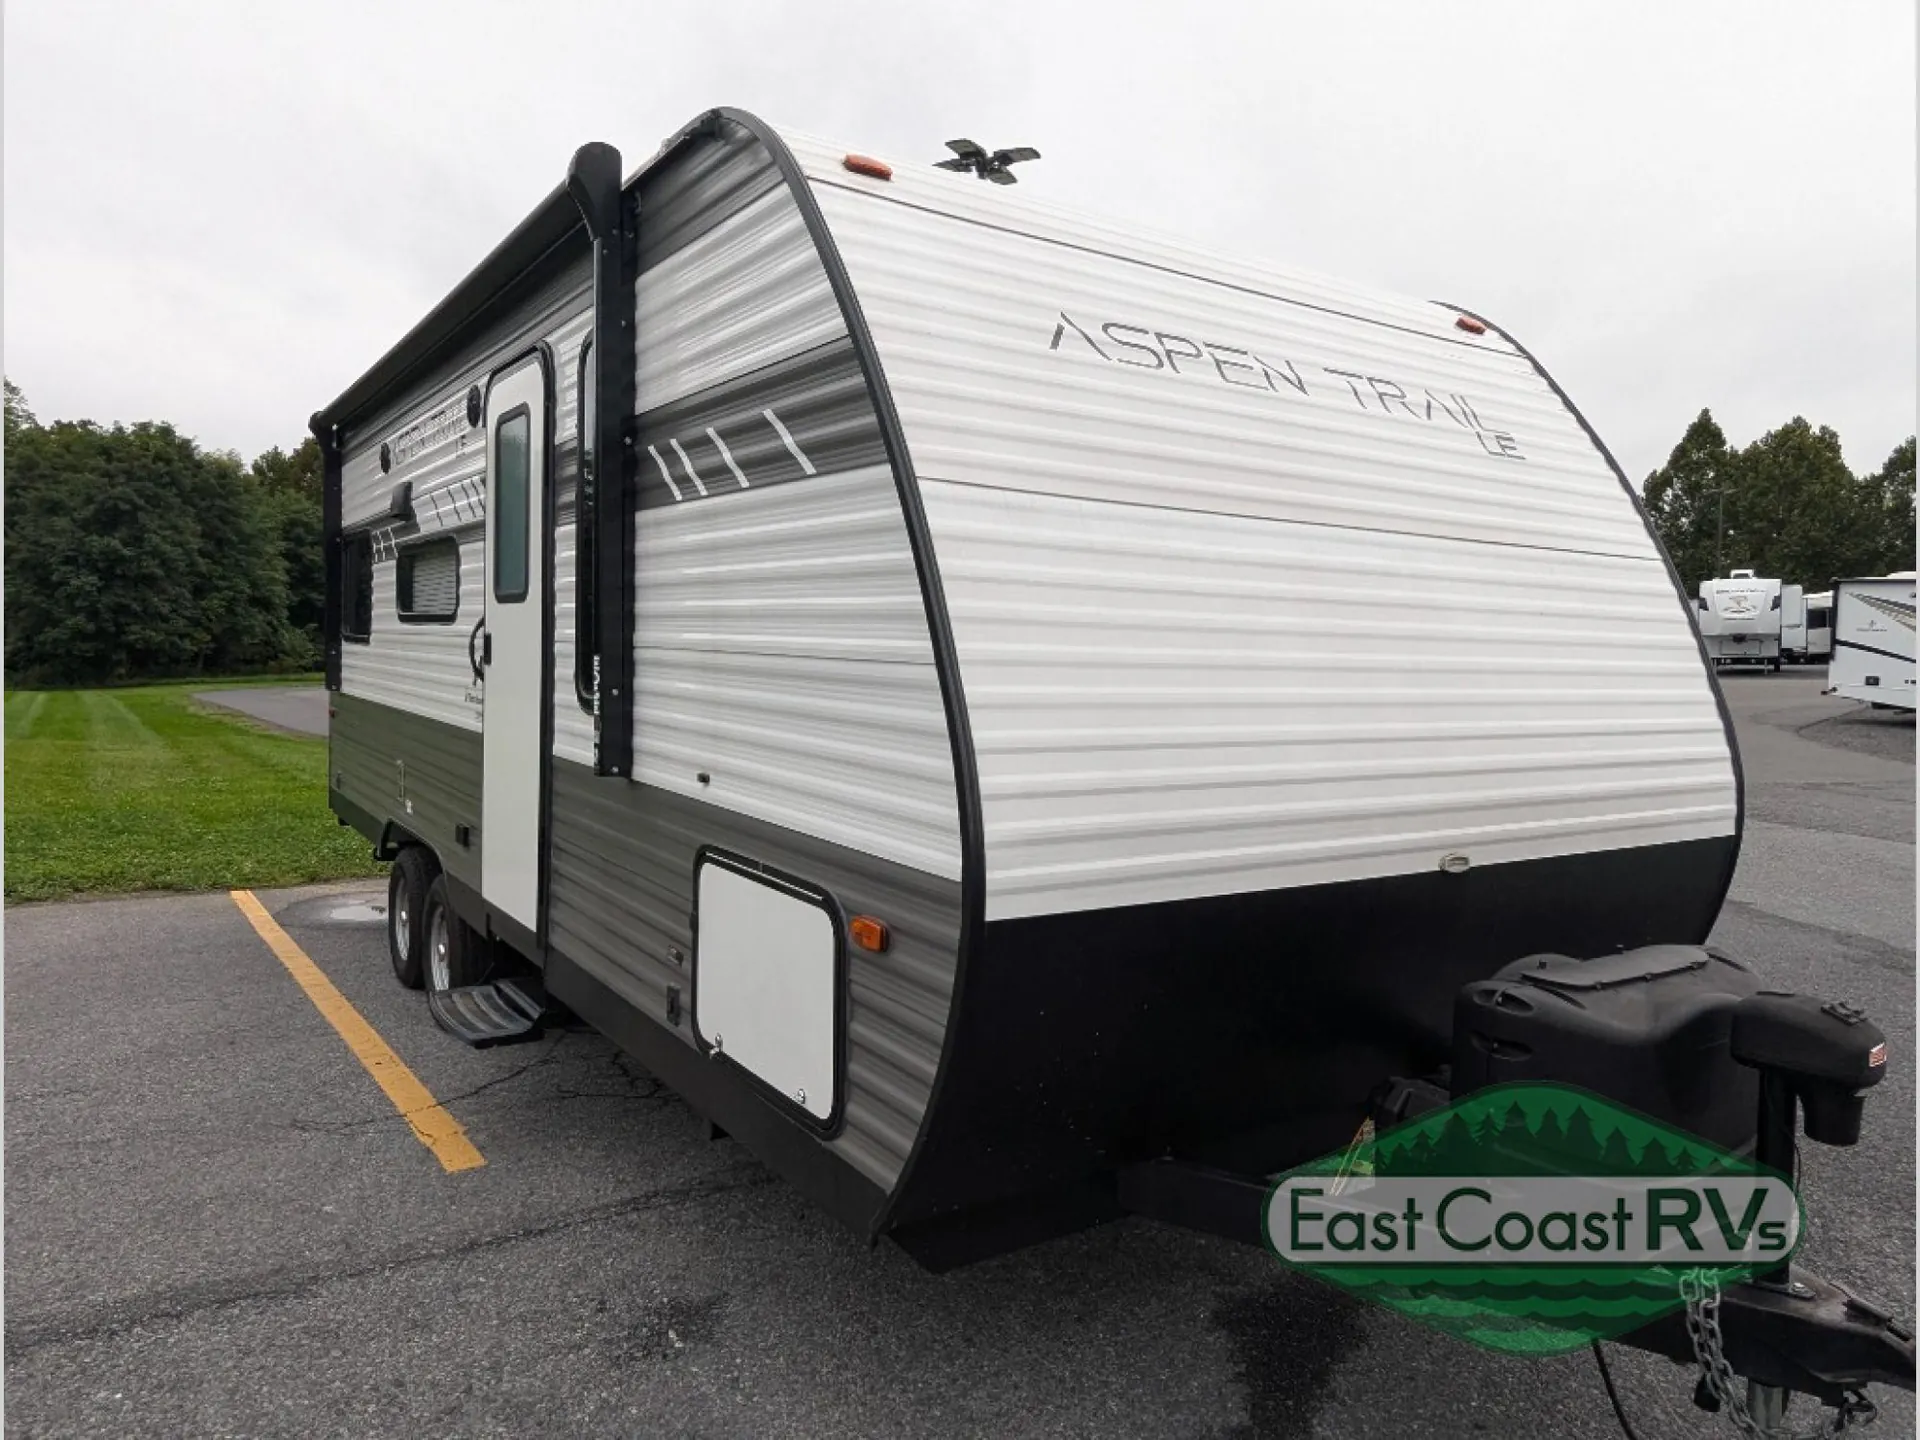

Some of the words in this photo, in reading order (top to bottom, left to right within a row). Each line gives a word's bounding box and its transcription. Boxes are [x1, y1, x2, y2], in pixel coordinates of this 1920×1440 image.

[1049, 312, 1310, 396] ASPEN
[1322, 366, 1511, 435] TRAIL
[1475, 431, 1526, 460] LE
